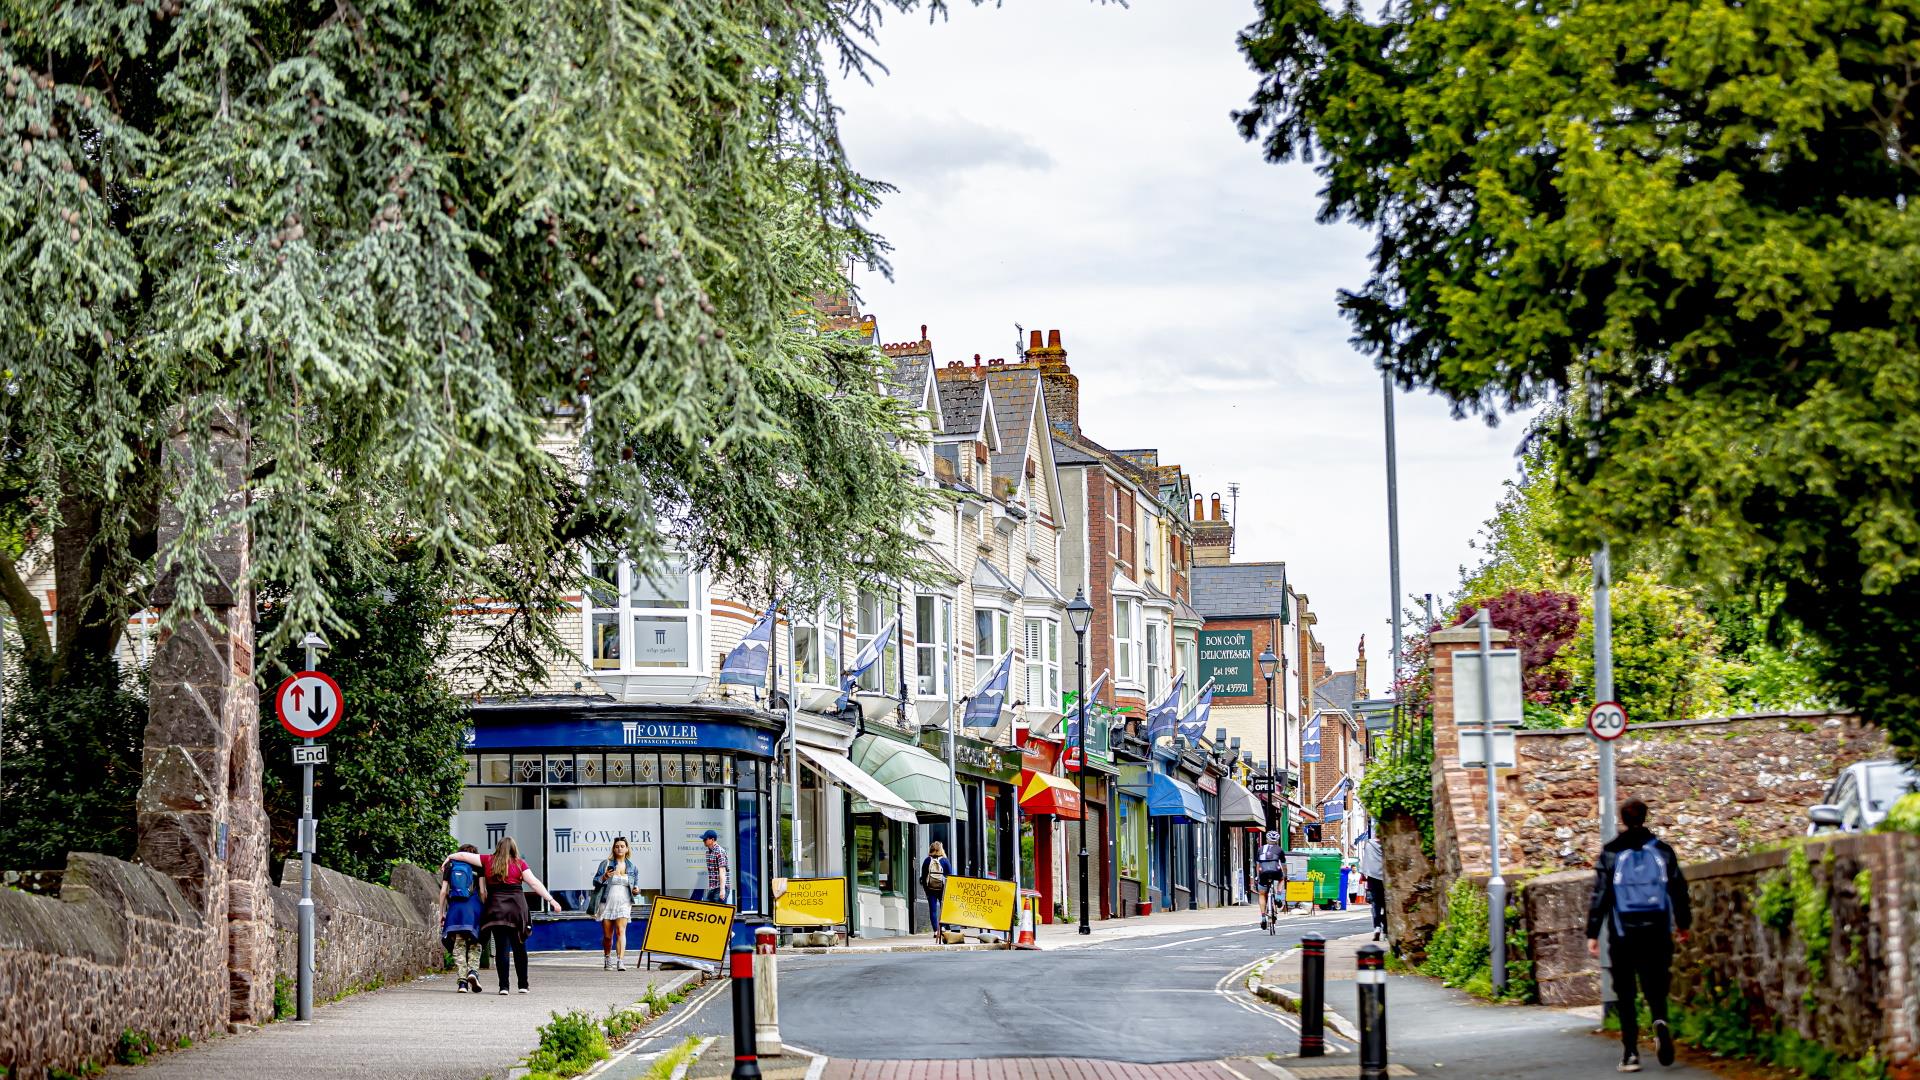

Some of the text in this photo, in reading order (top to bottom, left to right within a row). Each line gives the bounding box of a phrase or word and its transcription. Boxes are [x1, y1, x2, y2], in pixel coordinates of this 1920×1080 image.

[1205, 636, 1222, 646] BON
[1200, 649, 1251, 660] DELICATESSEN
[1224, 666, 1239, 676] 1987
[1595, 711, 1622, 729] 20
[636, 724, 698, 737] FOWLER
[296, 747, 325, 762] End
[798, 883, 812, 891] NO
[956, 881, 1001, 893] WONFORD
[786, 890, 828, 899] THROUGH
[962, 888, 987, 898] ROAD
[788, 898, 824, 906] ACCESS
[949, 893, 1004, 907] RESIDENTIAL
[959, 902, 993, 914] ACCESS
[659, 907, 727, 926] DIVERSION
[962, 910, 986, 919] ONLY
[674, 931, 700, 943] END
